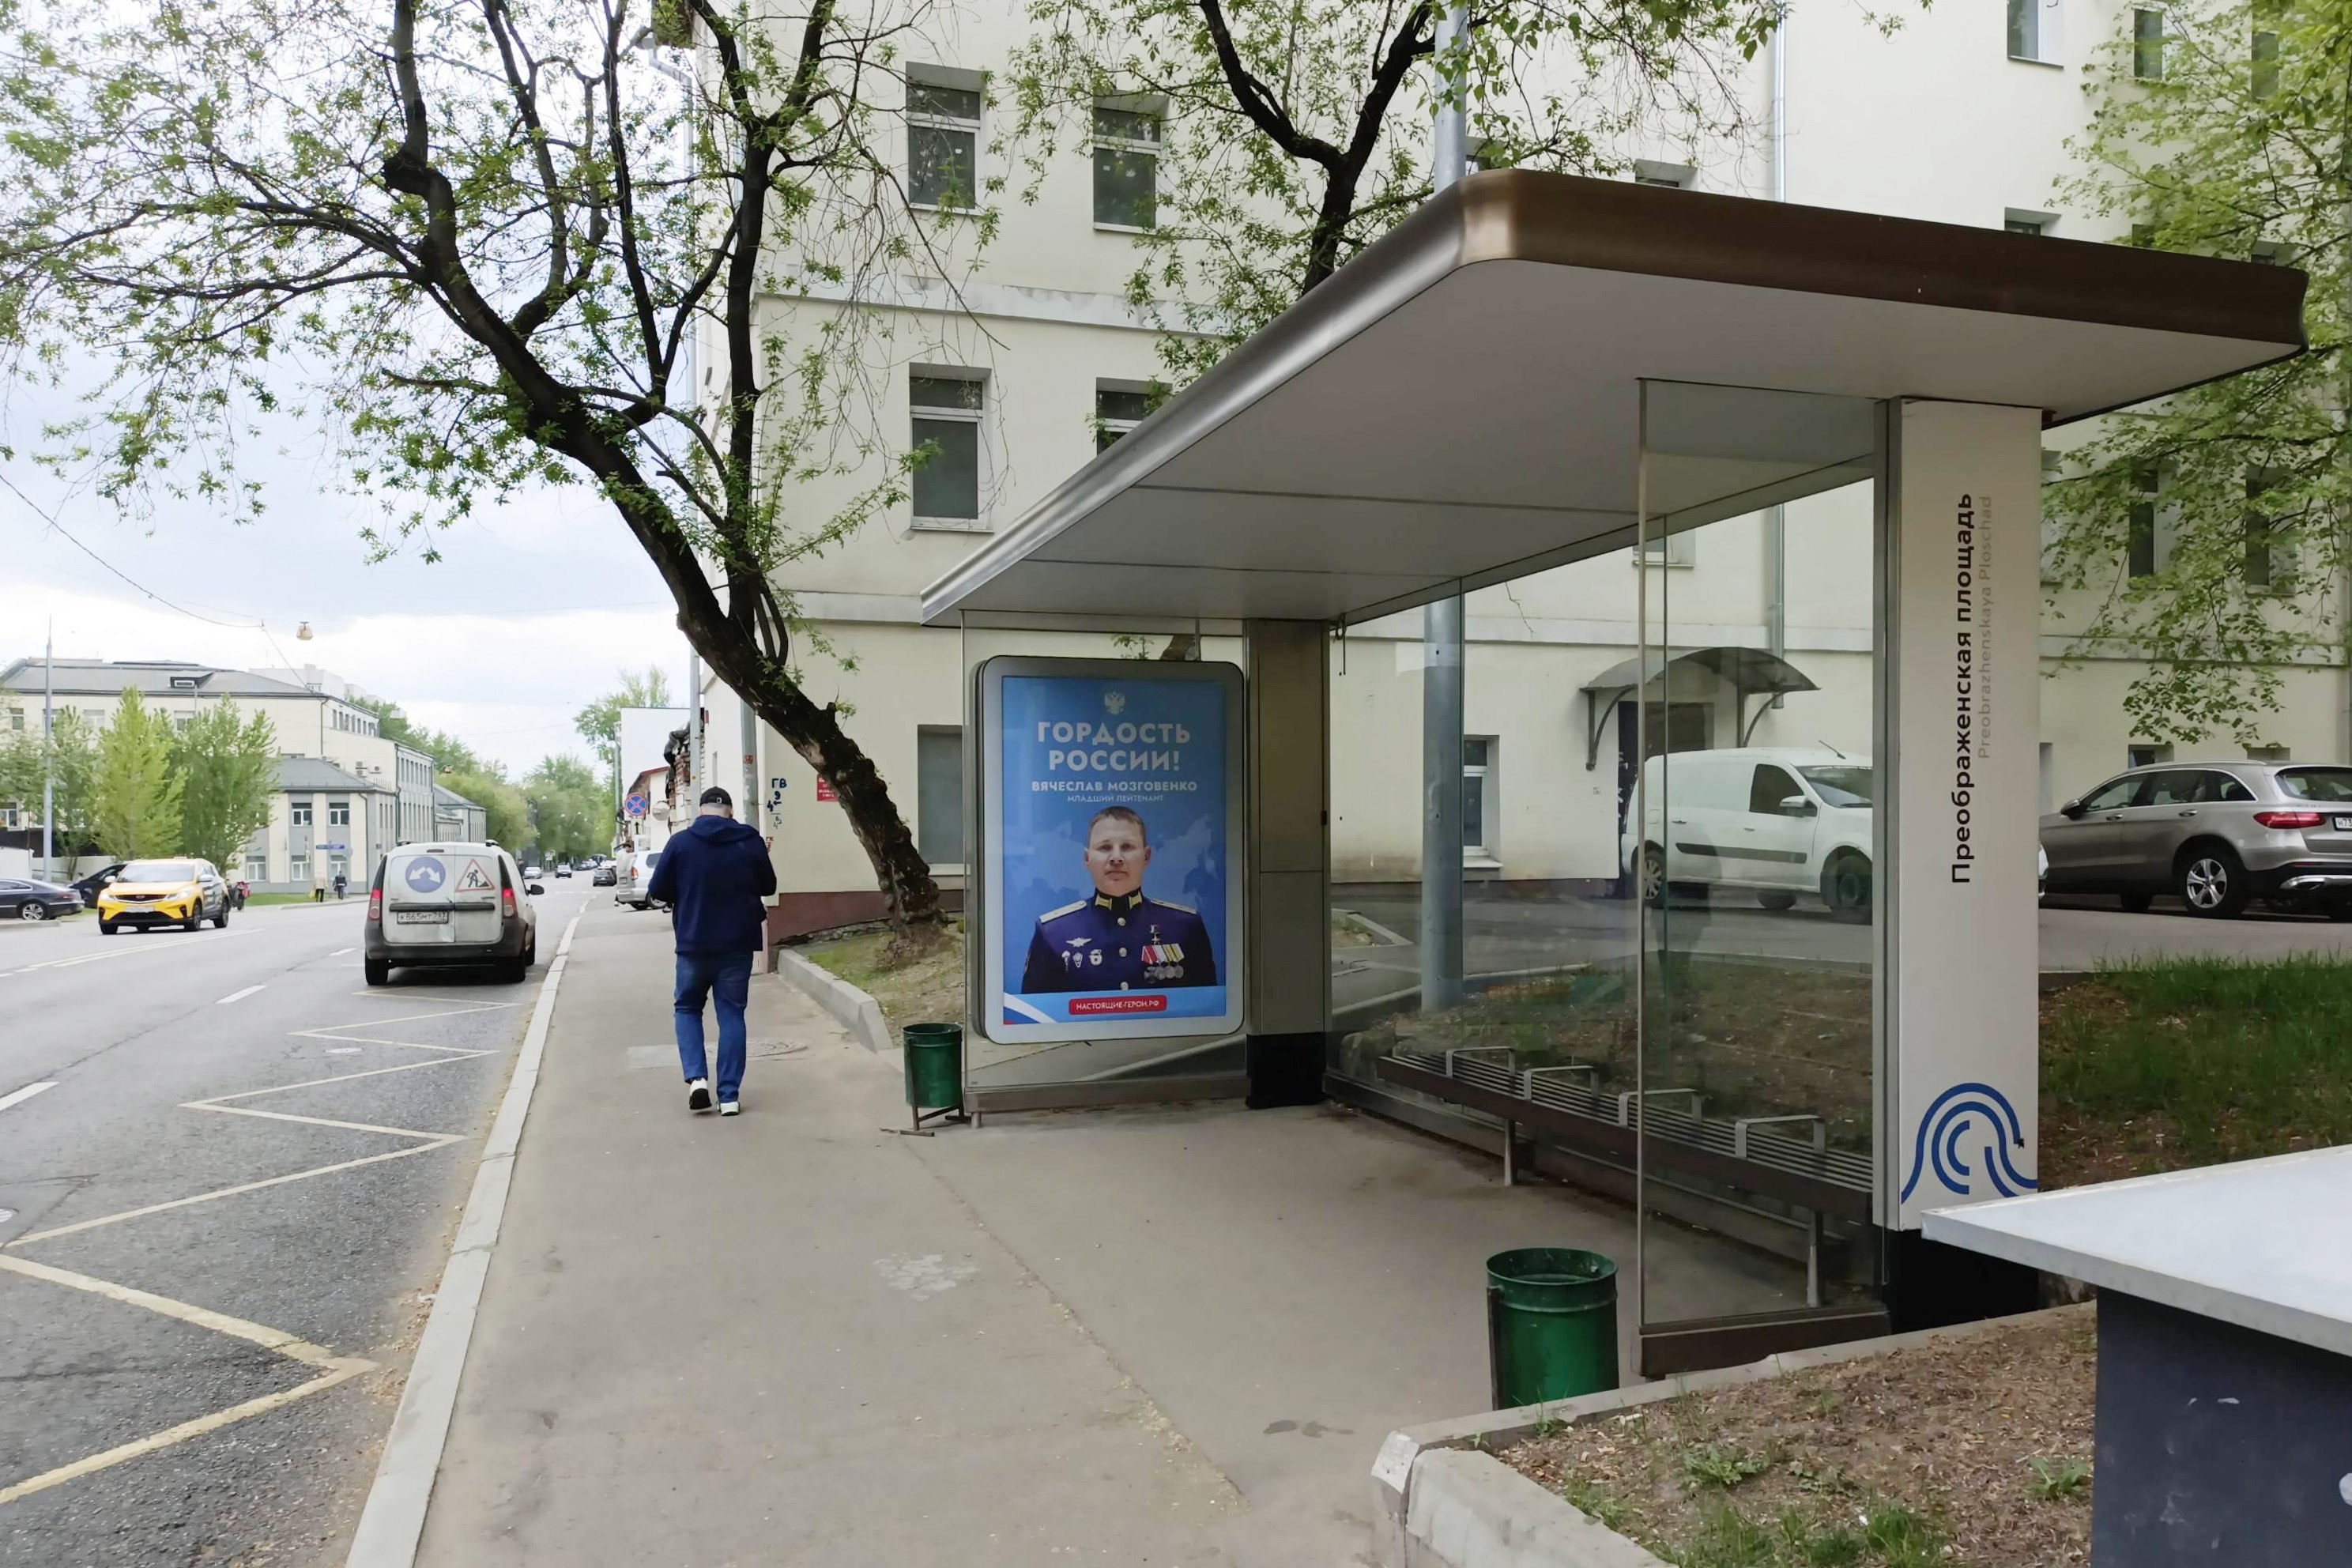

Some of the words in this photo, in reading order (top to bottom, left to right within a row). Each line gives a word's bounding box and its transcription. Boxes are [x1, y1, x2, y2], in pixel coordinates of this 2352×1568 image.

[1977, 496, 1993, 581] Ploschad
[1955, 494, 1975, 623] площадь
[1977, 587, 1994, 759] Preobrazhenskaya
[1037, 722, 1192, 745] ГОРДОСТЬ
[1048, 749, 1182, 772] РОССИИ!
[1952, 631, 1975, 884] Преображенская
[1031, 781, 1103, 792] ВЯЧЕСЛАВ
[1107, 781, 1198, 792] МОЗГОВЕНКО
[1067, 793, 1114, 802] МЛАДШИЙ
[1076, 1000, 1160, 1010] НАСТОЯЩИЕ-ГЕРОИ.РФ
